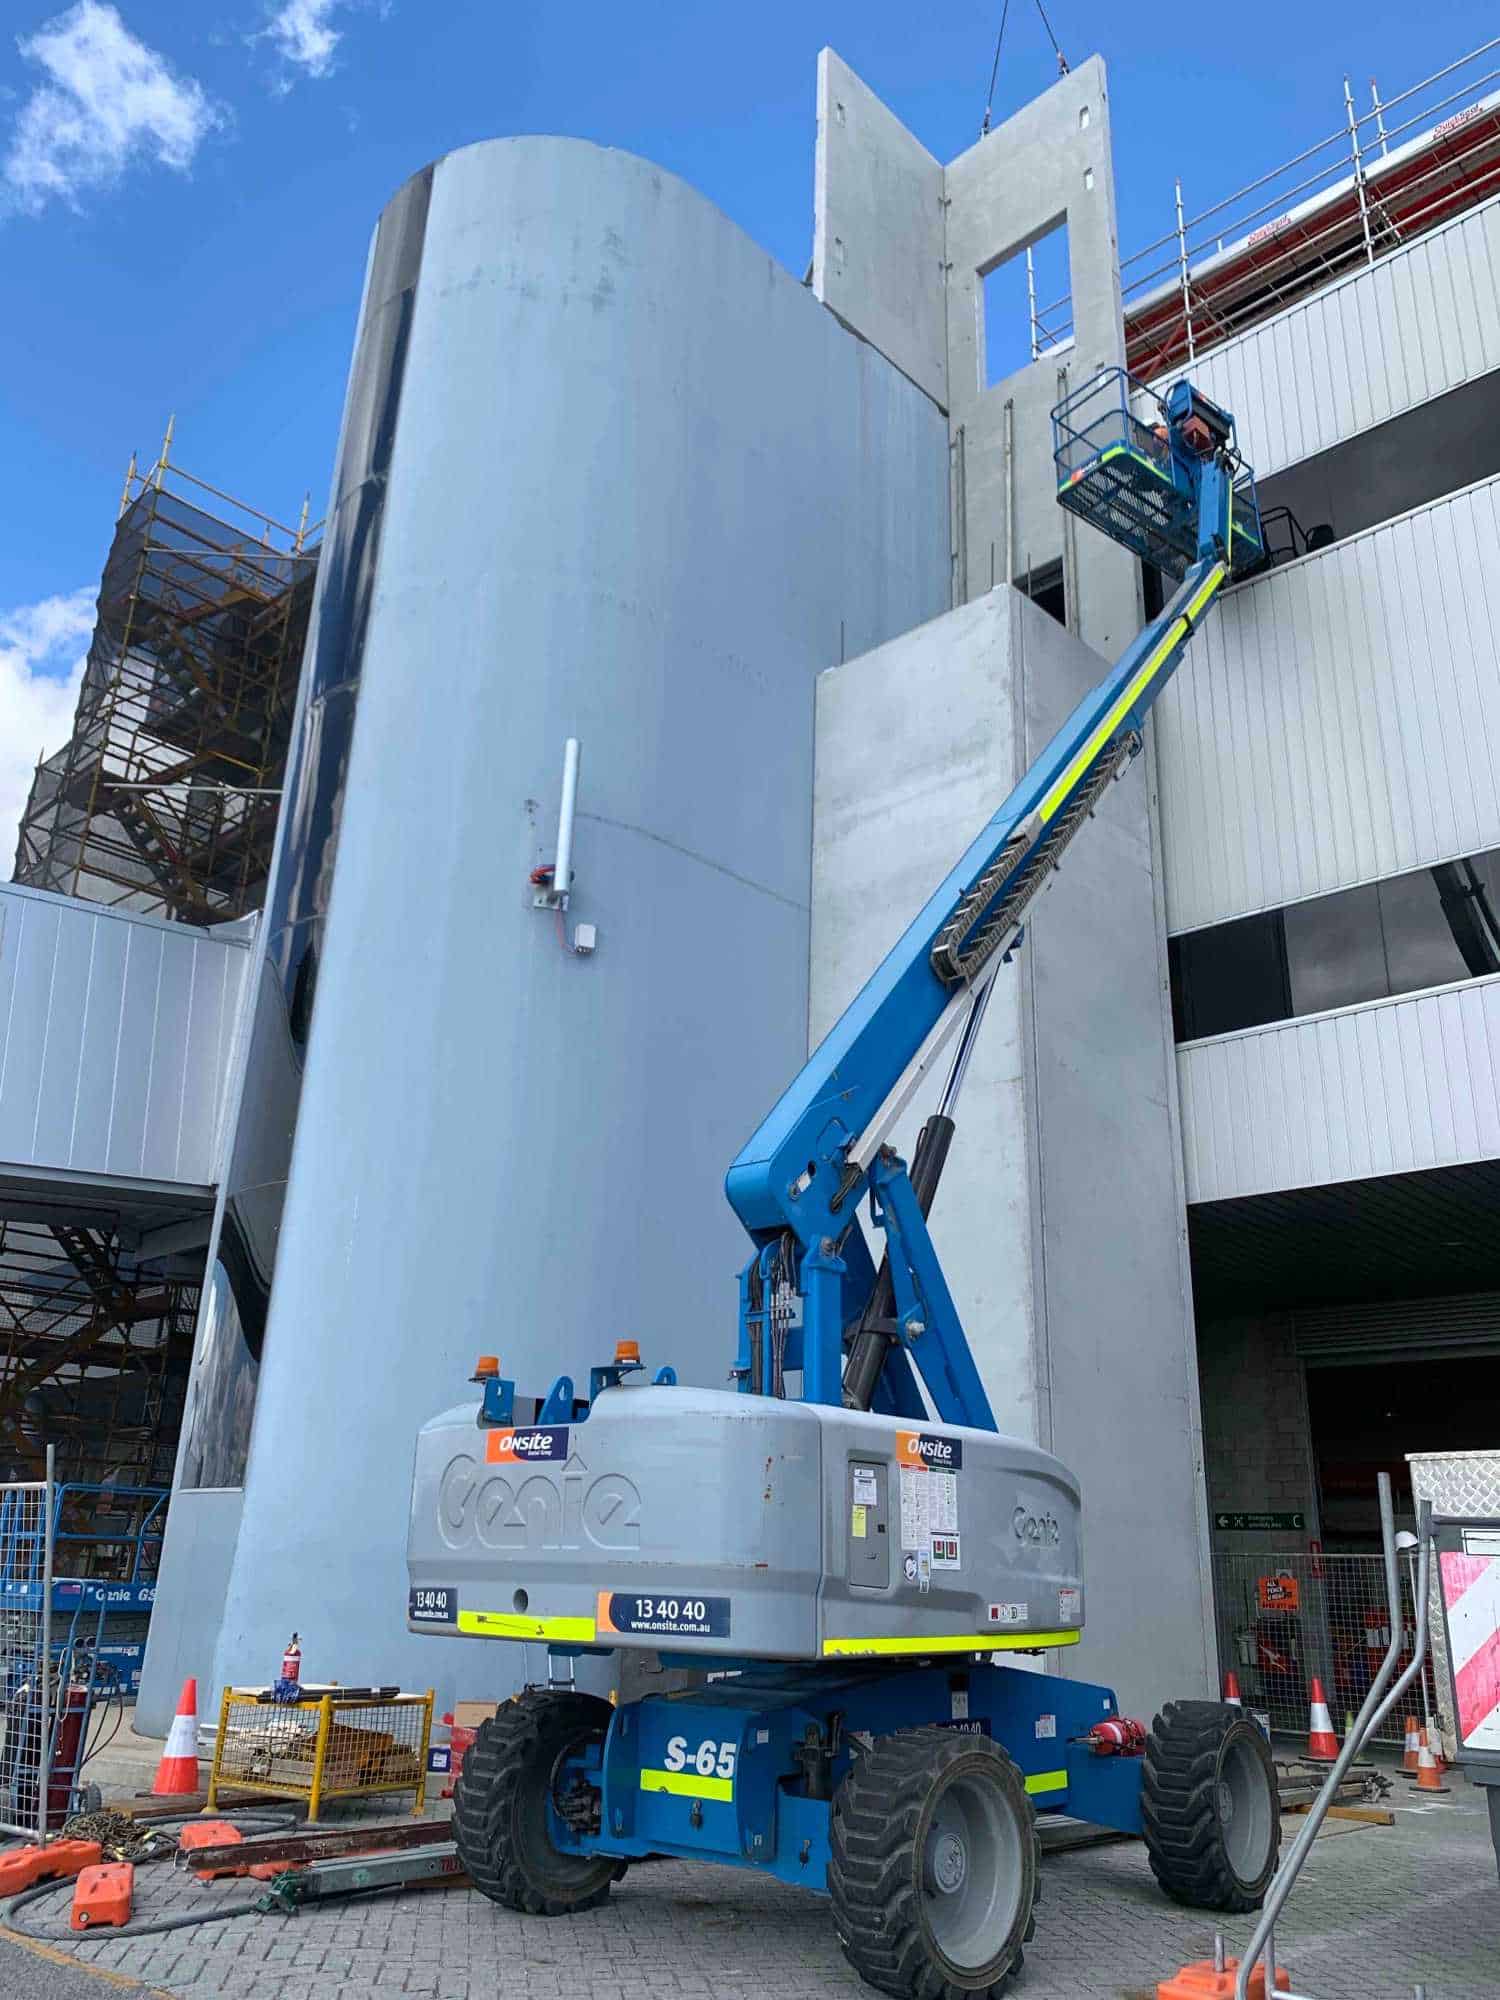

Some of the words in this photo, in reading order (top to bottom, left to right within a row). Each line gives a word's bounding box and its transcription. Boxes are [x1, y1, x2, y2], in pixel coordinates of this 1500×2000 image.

[437, 1453, 641, 1549] Genie
[416, 1591, 424, 1608] 13
[425, 1591, 435, 1608] 40
[436, 1591, 447, 1609] 40
[635, 1599, 653, 1618] 13
[656, 1600, 679, 1619] 40
[682, 1601, 705, 1621] 40
[630, 1619, 711, 1633] www.onsite.com.au
[664, 1736, 737, 1778] S-65
